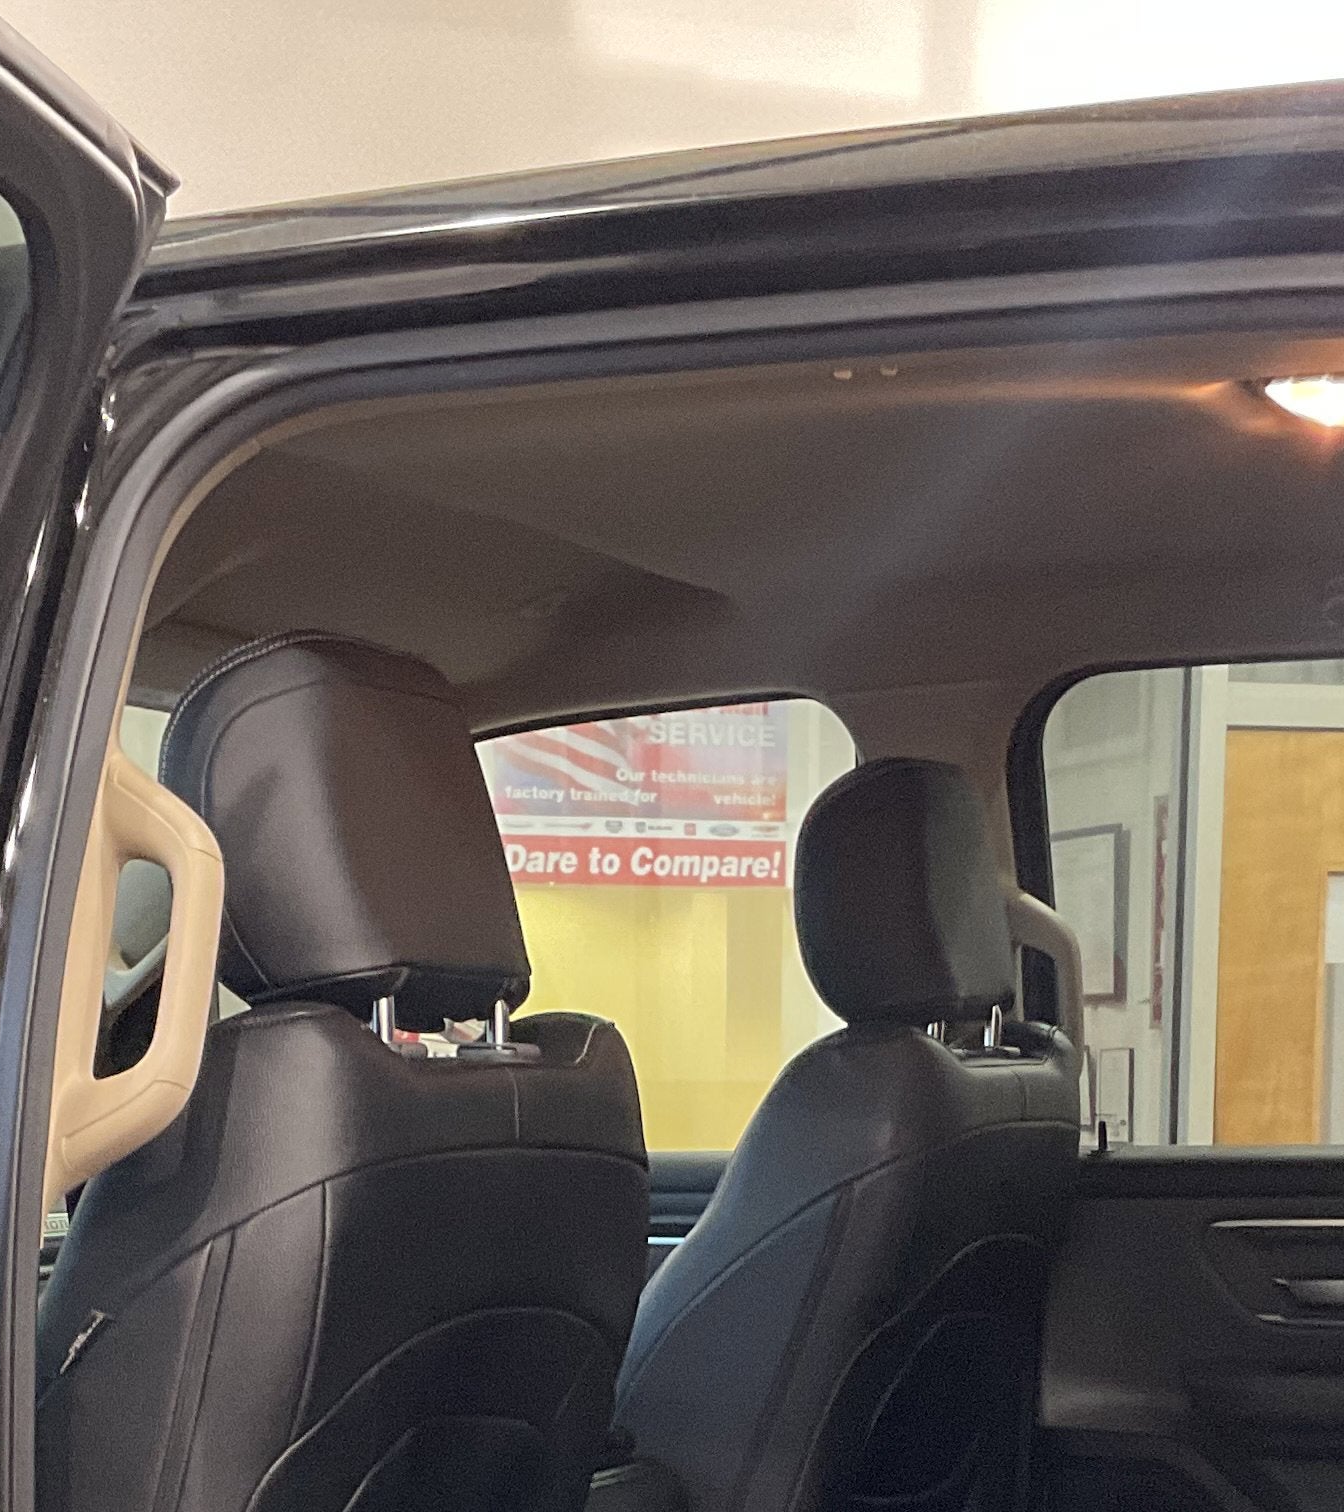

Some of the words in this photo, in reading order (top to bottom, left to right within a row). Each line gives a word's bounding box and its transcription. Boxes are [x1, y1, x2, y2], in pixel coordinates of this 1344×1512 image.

[649, 721, 777, 748] SERVICE
[616, 767, 645, 783] Our
[652, 769, 745, 786] technicians
[505, 785, 564, 803] factory
[570, 787, 630, 803] trained
[631, 788, 658, 804] for
[503, 843, 578, 874] Dare
[589, 846, 620, 875] to
[630, 845, 783, 884] Compare!
